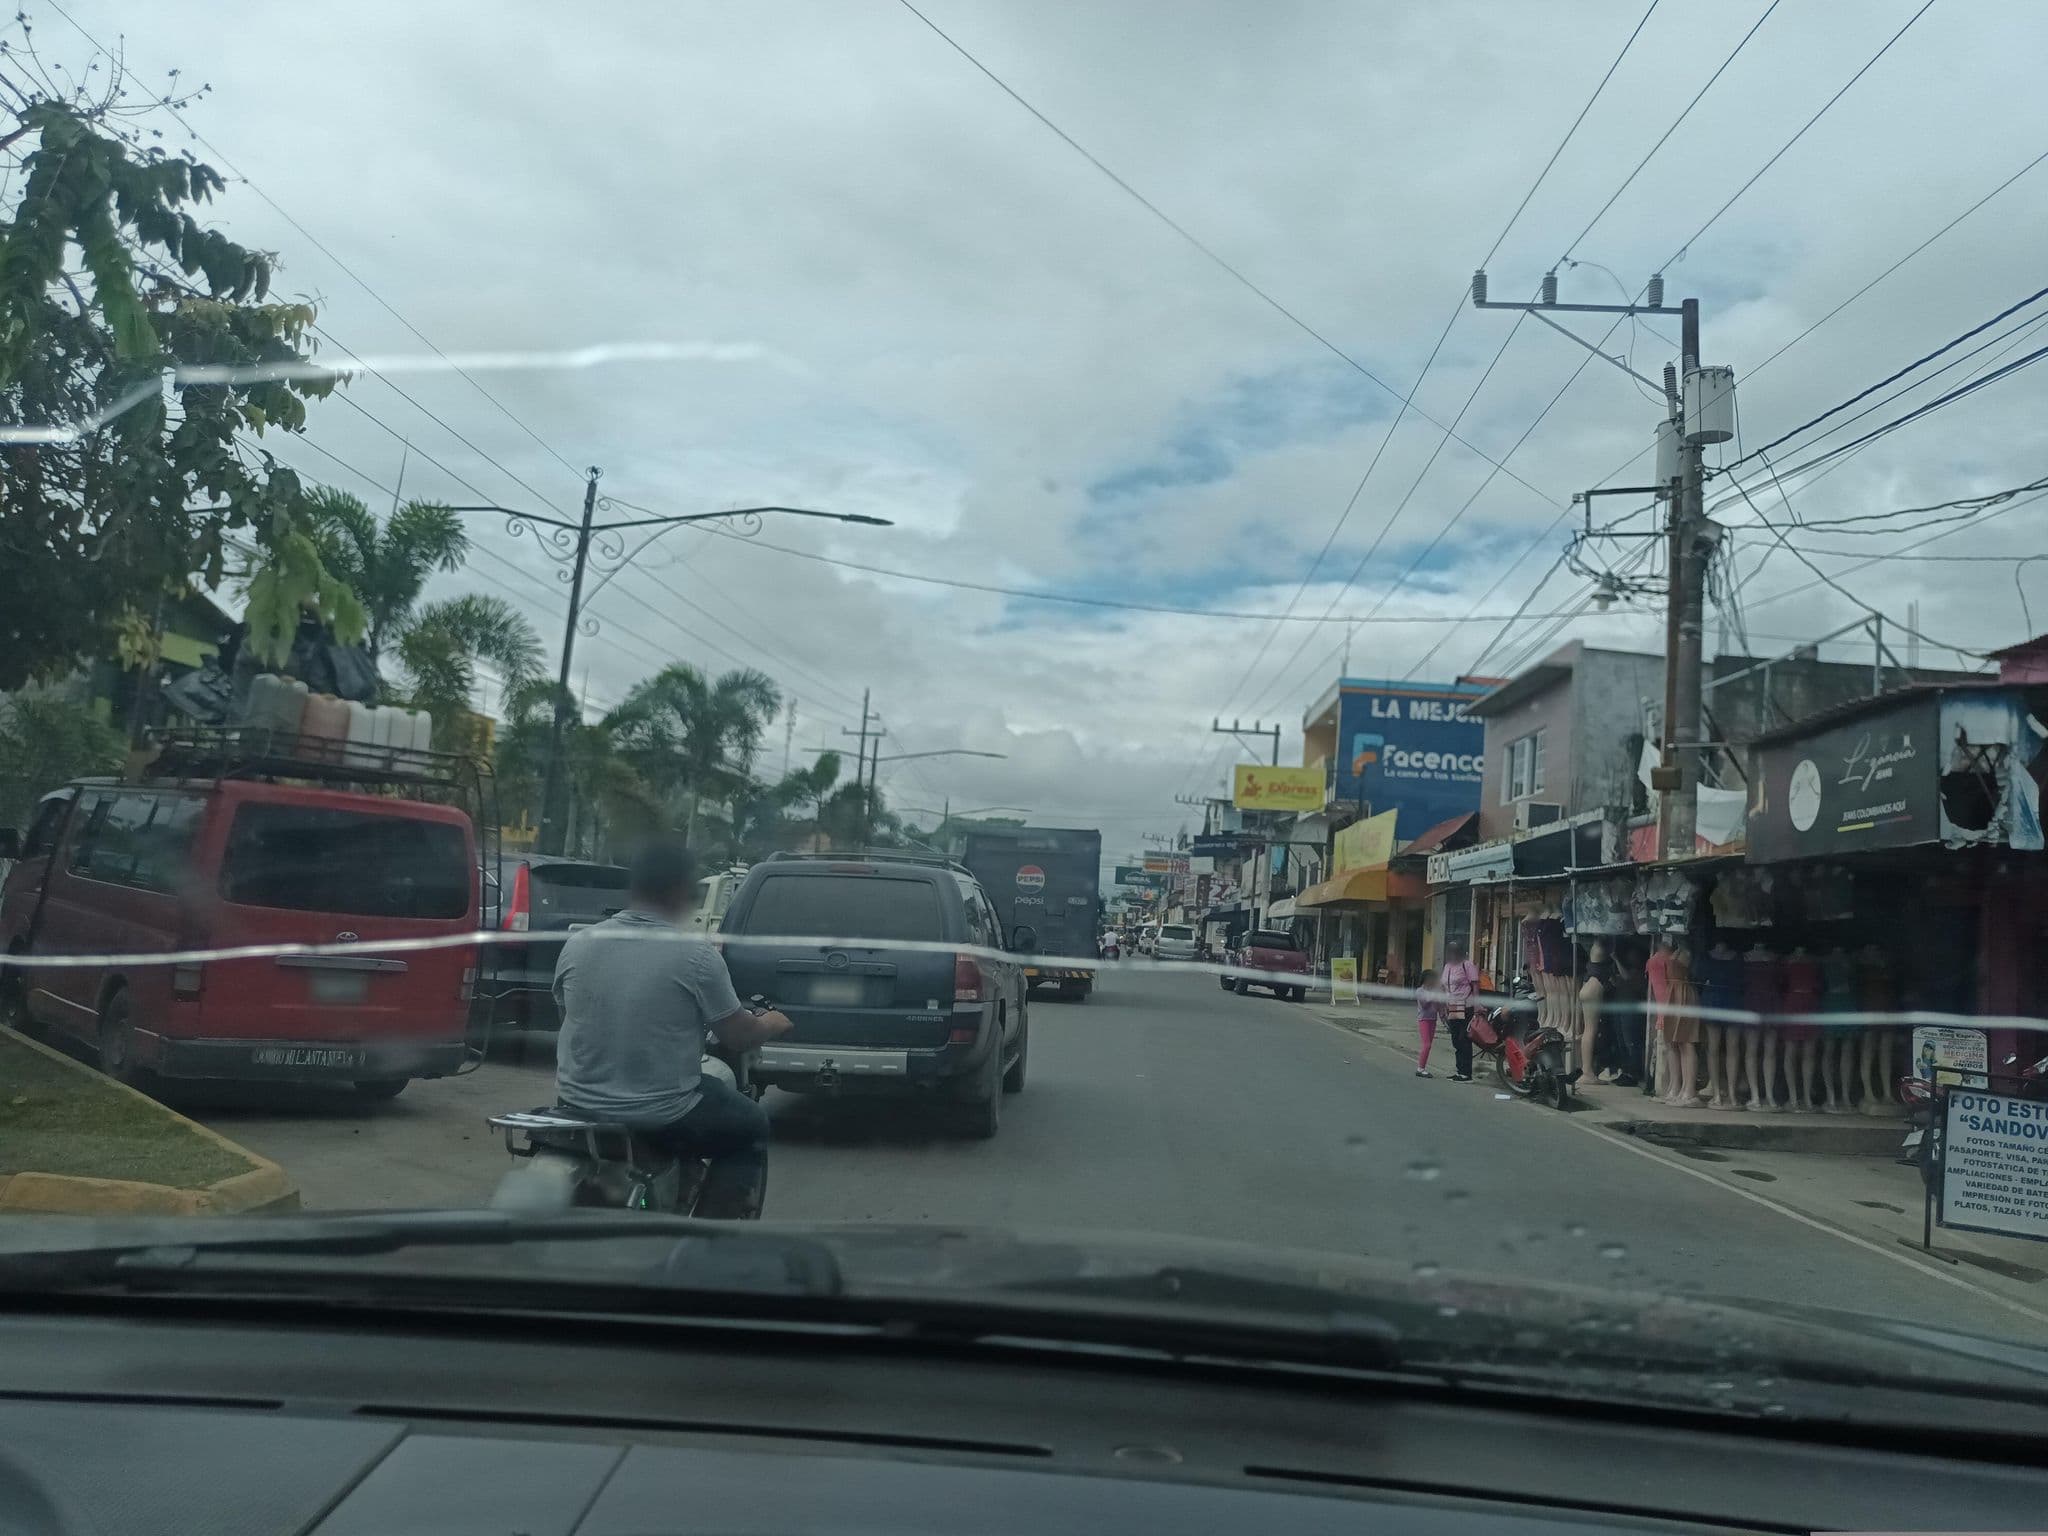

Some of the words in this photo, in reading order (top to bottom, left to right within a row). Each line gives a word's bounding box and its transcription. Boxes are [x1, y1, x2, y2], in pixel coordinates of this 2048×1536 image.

[1371, 698, 1401, 719] LA
[1015, 896, 1045, 906] pepsi
[1950, 1096, 2001, 1114] FOTO
[2007, 1102, 2048, 1121] EST
[1966, 1136, 1996, 1148] FOTOS
[1949, 1145, 2003, 1160] PASAPORTE,
[2006, 1153, 2029, 1164] VISA,
[1947, 1167, 2013, 1182] AMPLIACIONES
[2027, 1167, 2039, 1175] DE
[1965, 1180, 2009, 1192] VARIEDAD
[2014, 1198, 2026, 1206] DE
[1954, 1200, 1990, 1213] PLATOS,
[1993, 1206, 2022, 1217] TAZAS
[2024, 1210, 2030, 1218] Y
